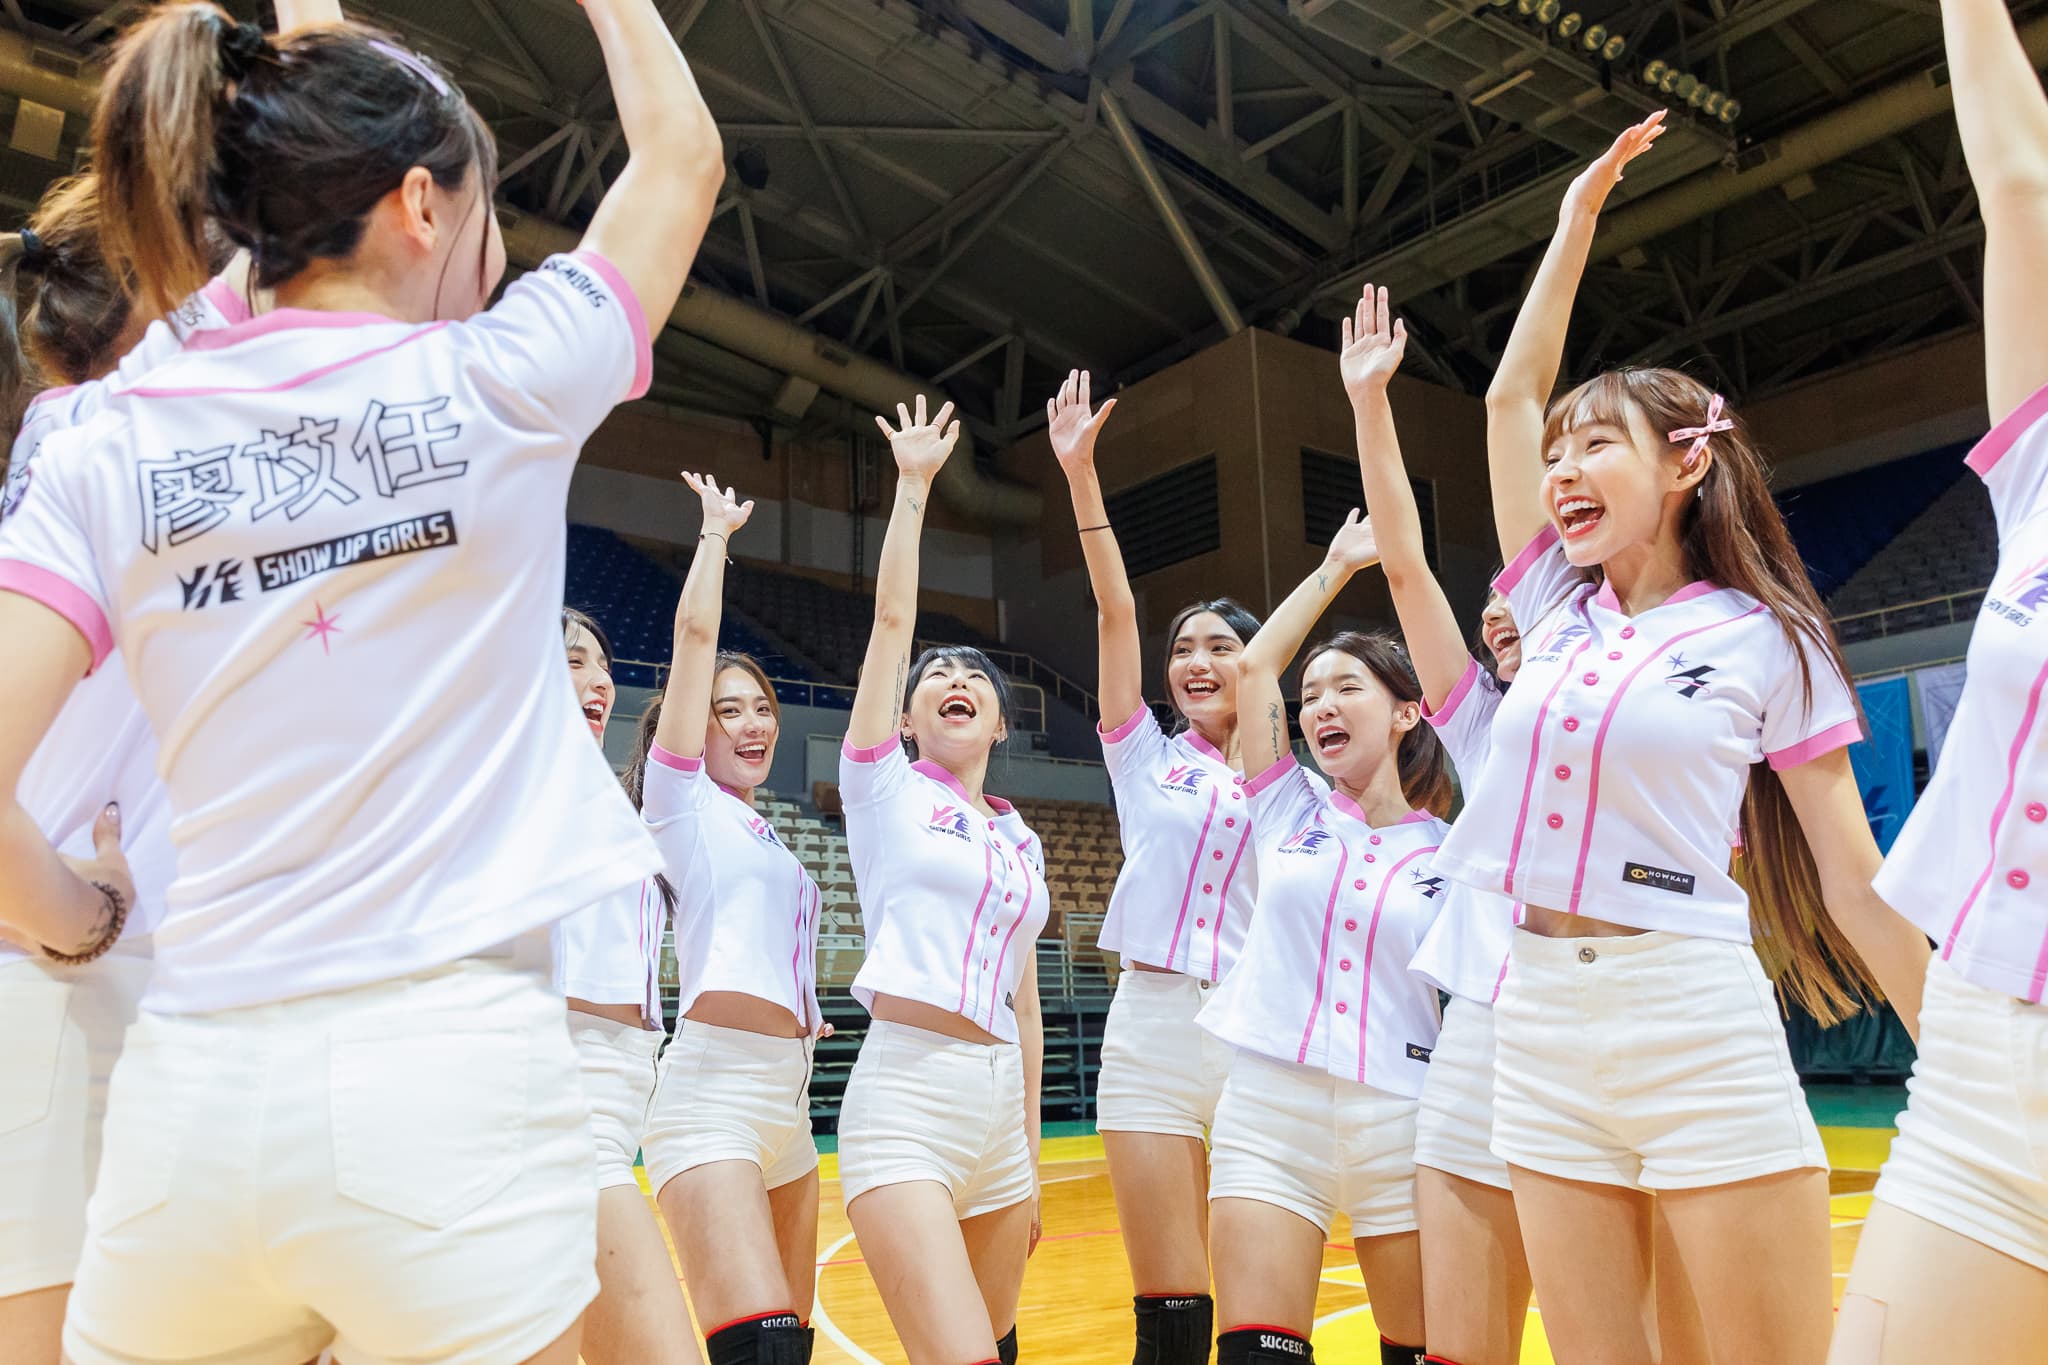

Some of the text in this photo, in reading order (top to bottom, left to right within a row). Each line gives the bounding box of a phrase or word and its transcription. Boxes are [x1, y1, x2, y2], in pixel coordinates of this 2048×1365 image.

[138, 396, 468, 556] 廖苡任
[259, 549, 334, 590] SHOW
[335, 537, 368, 565] UP
[371, 514, 450, 558] GIRLS
[1648, 870, 1689, 884] HOWKAN
[1260, 1334, 1304, 1355] SUCCESS
